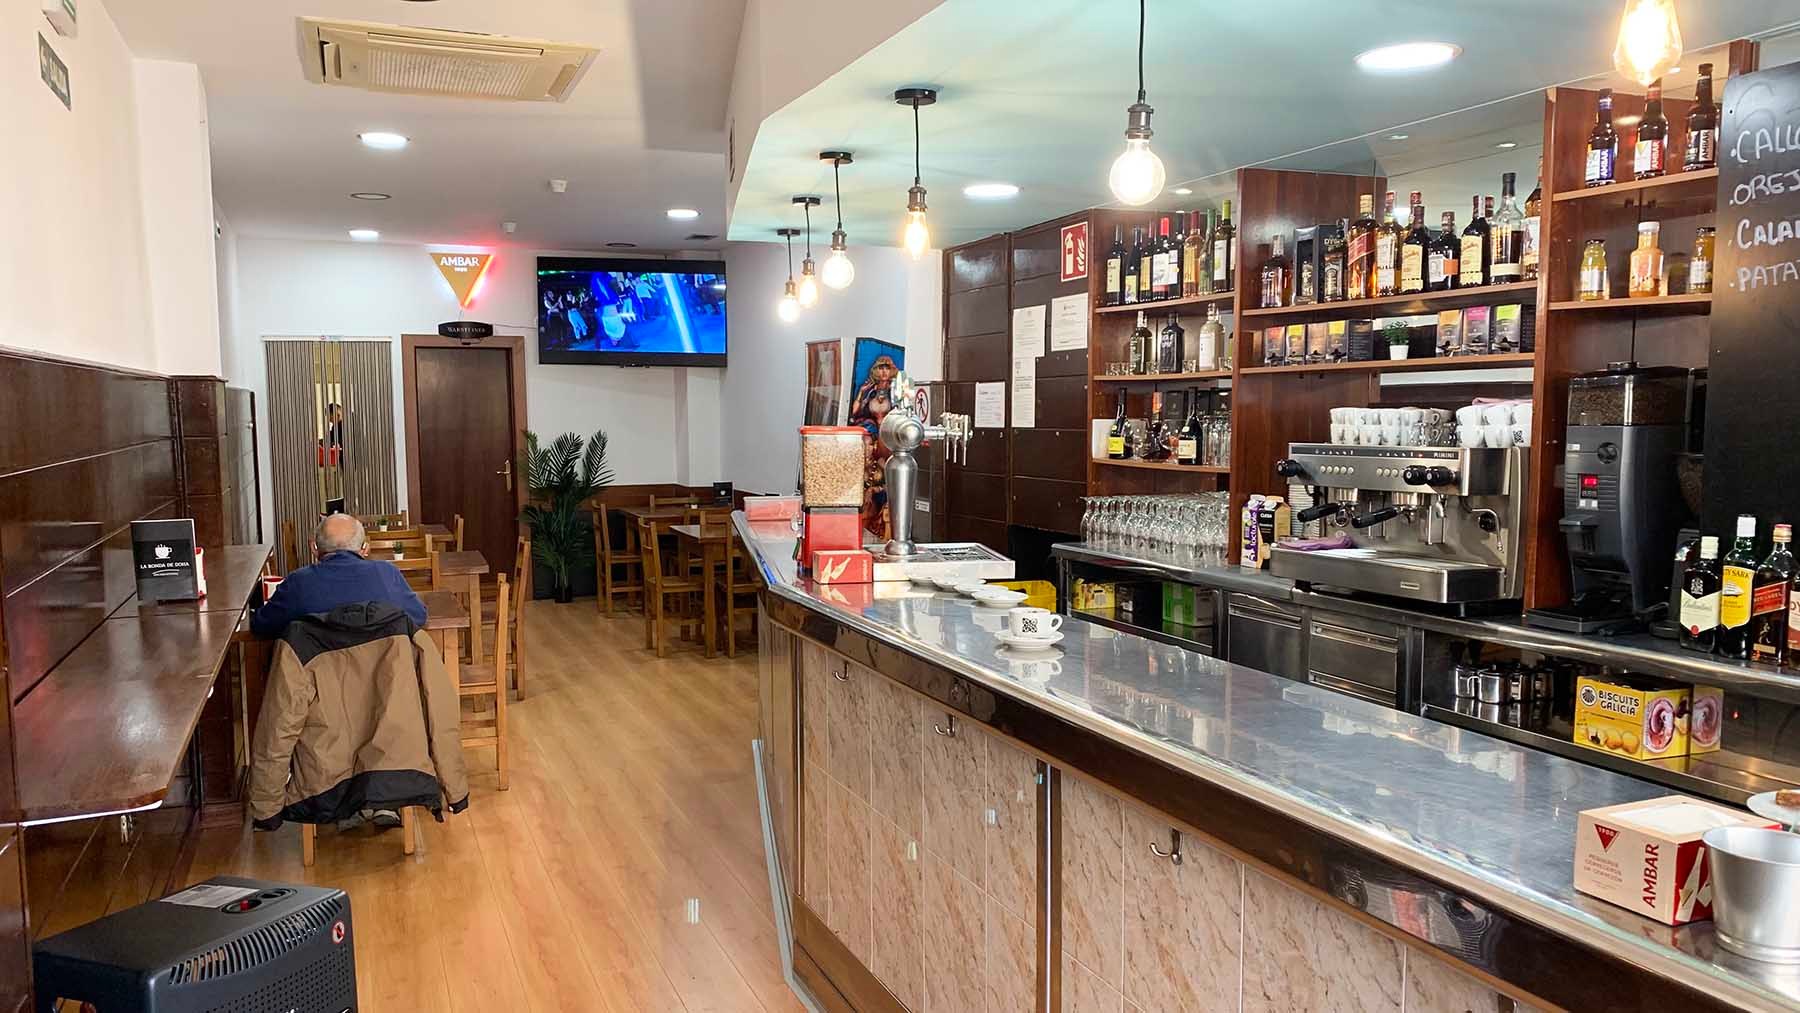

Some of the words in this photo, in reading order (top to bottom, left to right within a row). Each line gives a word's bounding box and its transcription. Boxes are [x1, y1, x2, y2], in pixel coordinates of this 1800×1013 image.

[1651, 140, 1660, 170] AMBAR
[1701, 131, 1711, 160] AMBAR
[1600, 149, 1609, 178] AMBAR
[440, 256, 480, 267] AMBAR
[1598, 690, 1640, 707] BISCUITS
[1600, 700, 1636, 716] GALICIA
[1642, 843, 1659, 909] AMBAR
